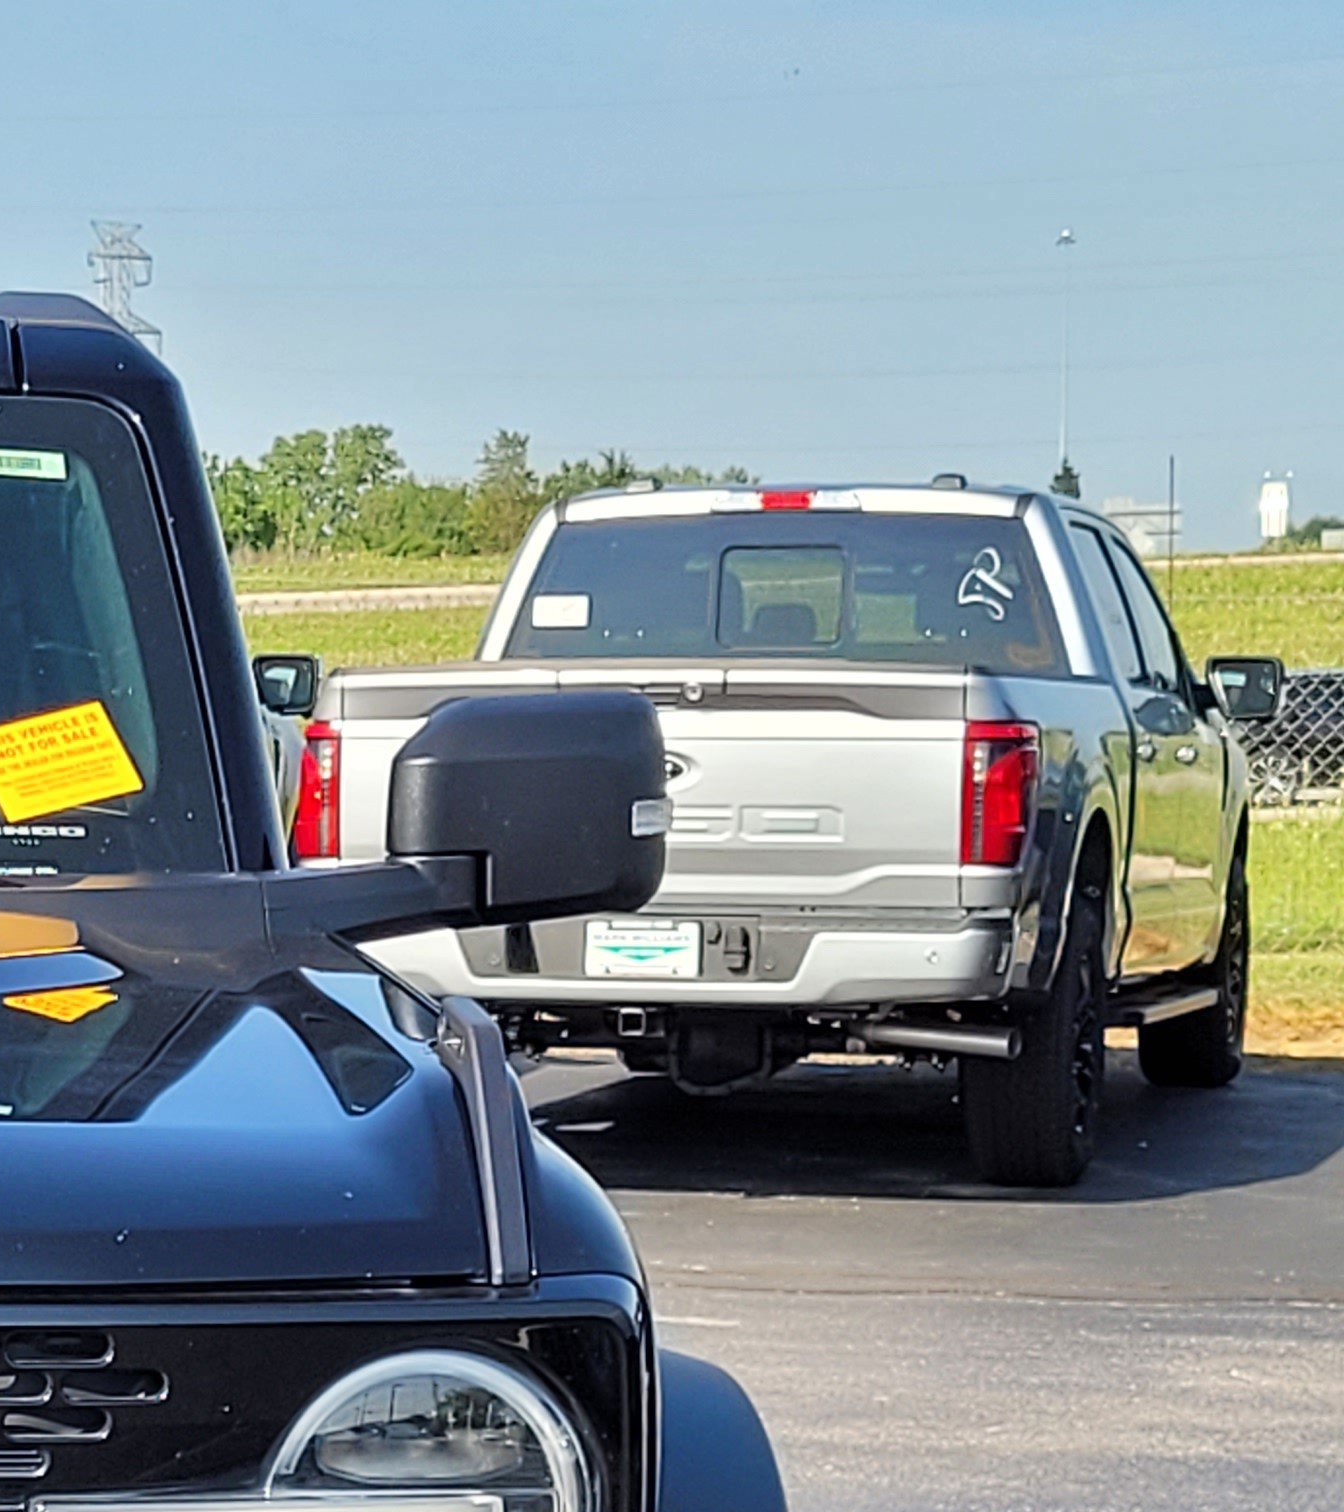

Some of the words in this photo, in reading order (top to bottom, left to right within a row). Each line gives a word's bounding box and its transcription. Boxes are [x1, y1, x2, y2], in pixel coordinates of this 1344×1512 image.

[18, 716, 81, 739] VEHICLE
[83, 711, 99, 724] IS
[28, 736, 58, 753] FOR
[61, 727, 99, 744] SALE
